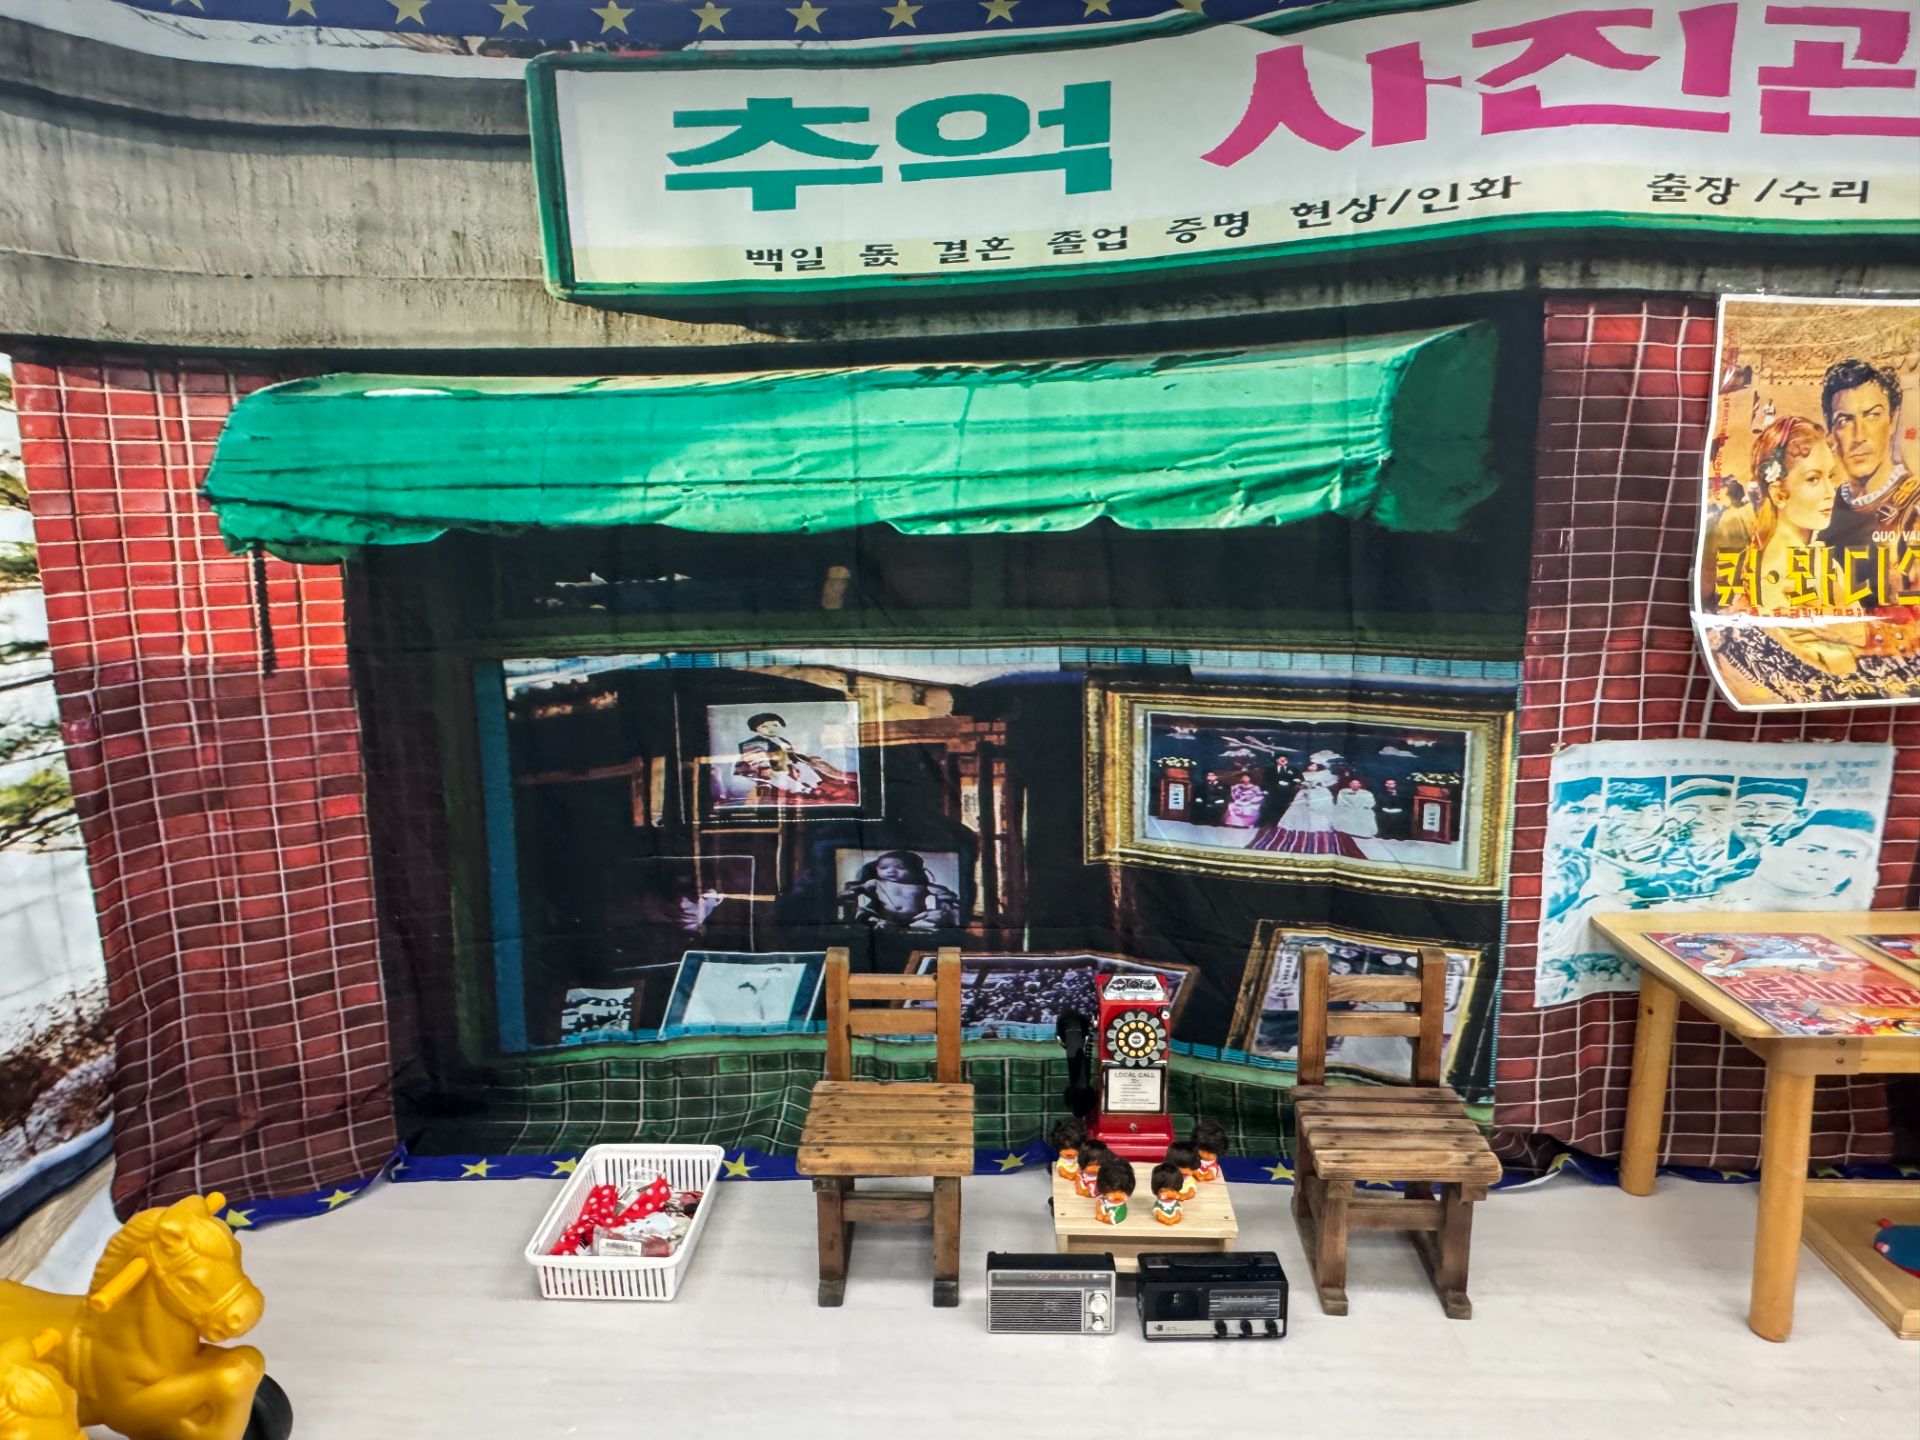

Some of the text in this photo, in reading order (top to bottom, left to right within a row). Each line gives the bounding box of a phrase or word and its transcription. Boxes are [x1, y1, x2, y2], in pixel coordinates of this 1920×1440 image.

[665, 81, 1112, 211] 추억
[745, 246, 826, 272] 백일
[860, 245, 899, 267] 돐
[934, 237, 1015, 264] 결혼
[1048, 225, 1128, 255] 졸업
[1166, 211, 1249, 243] 증명
[1290, 175, 1522, 230] 현상/인화
[1647, 173, 1740, 206] 출장
[1872, 531, 1896, 542] QUO
